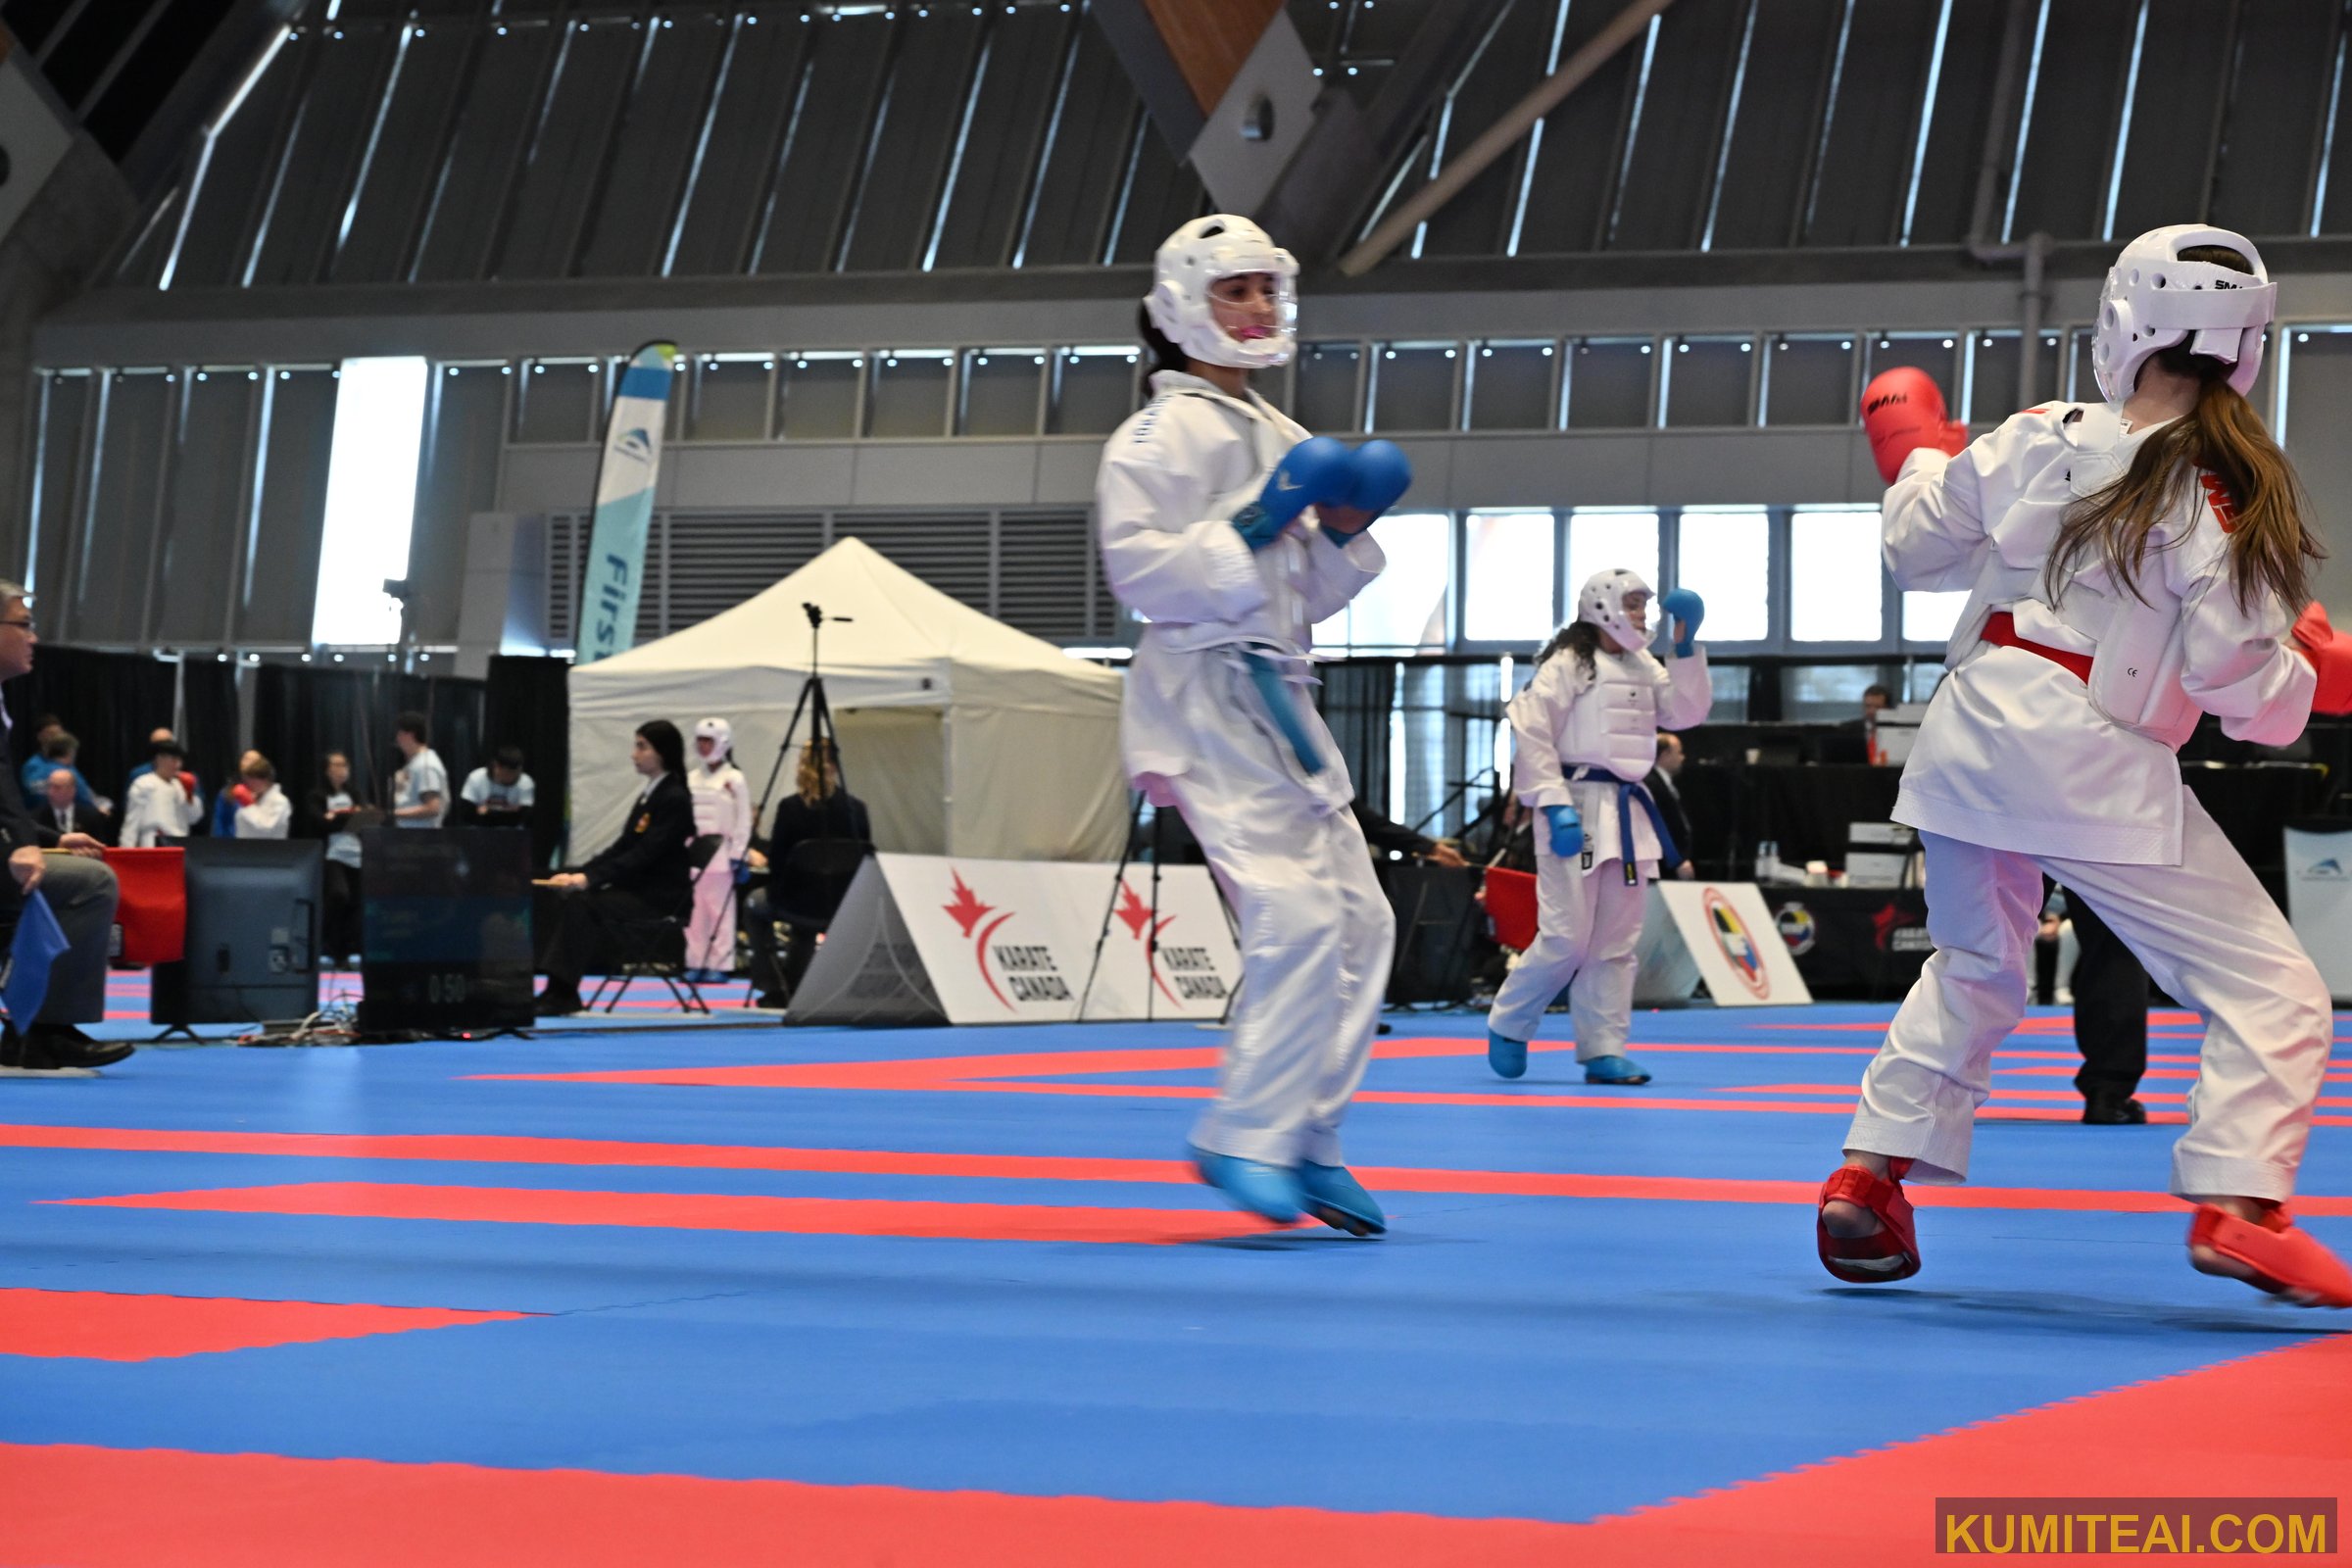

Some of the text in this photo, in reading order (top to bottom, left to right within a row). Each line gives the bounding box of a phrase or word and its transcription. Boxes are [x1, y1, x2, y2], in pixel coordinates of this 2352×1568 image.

[992, 946, 1057, 971] KARATE
[1159, 947, 1216, 971] KARATE
[1007, 976, 1075, 1002] CANADA
[1174, 975, 1229, 1000] CANADA
